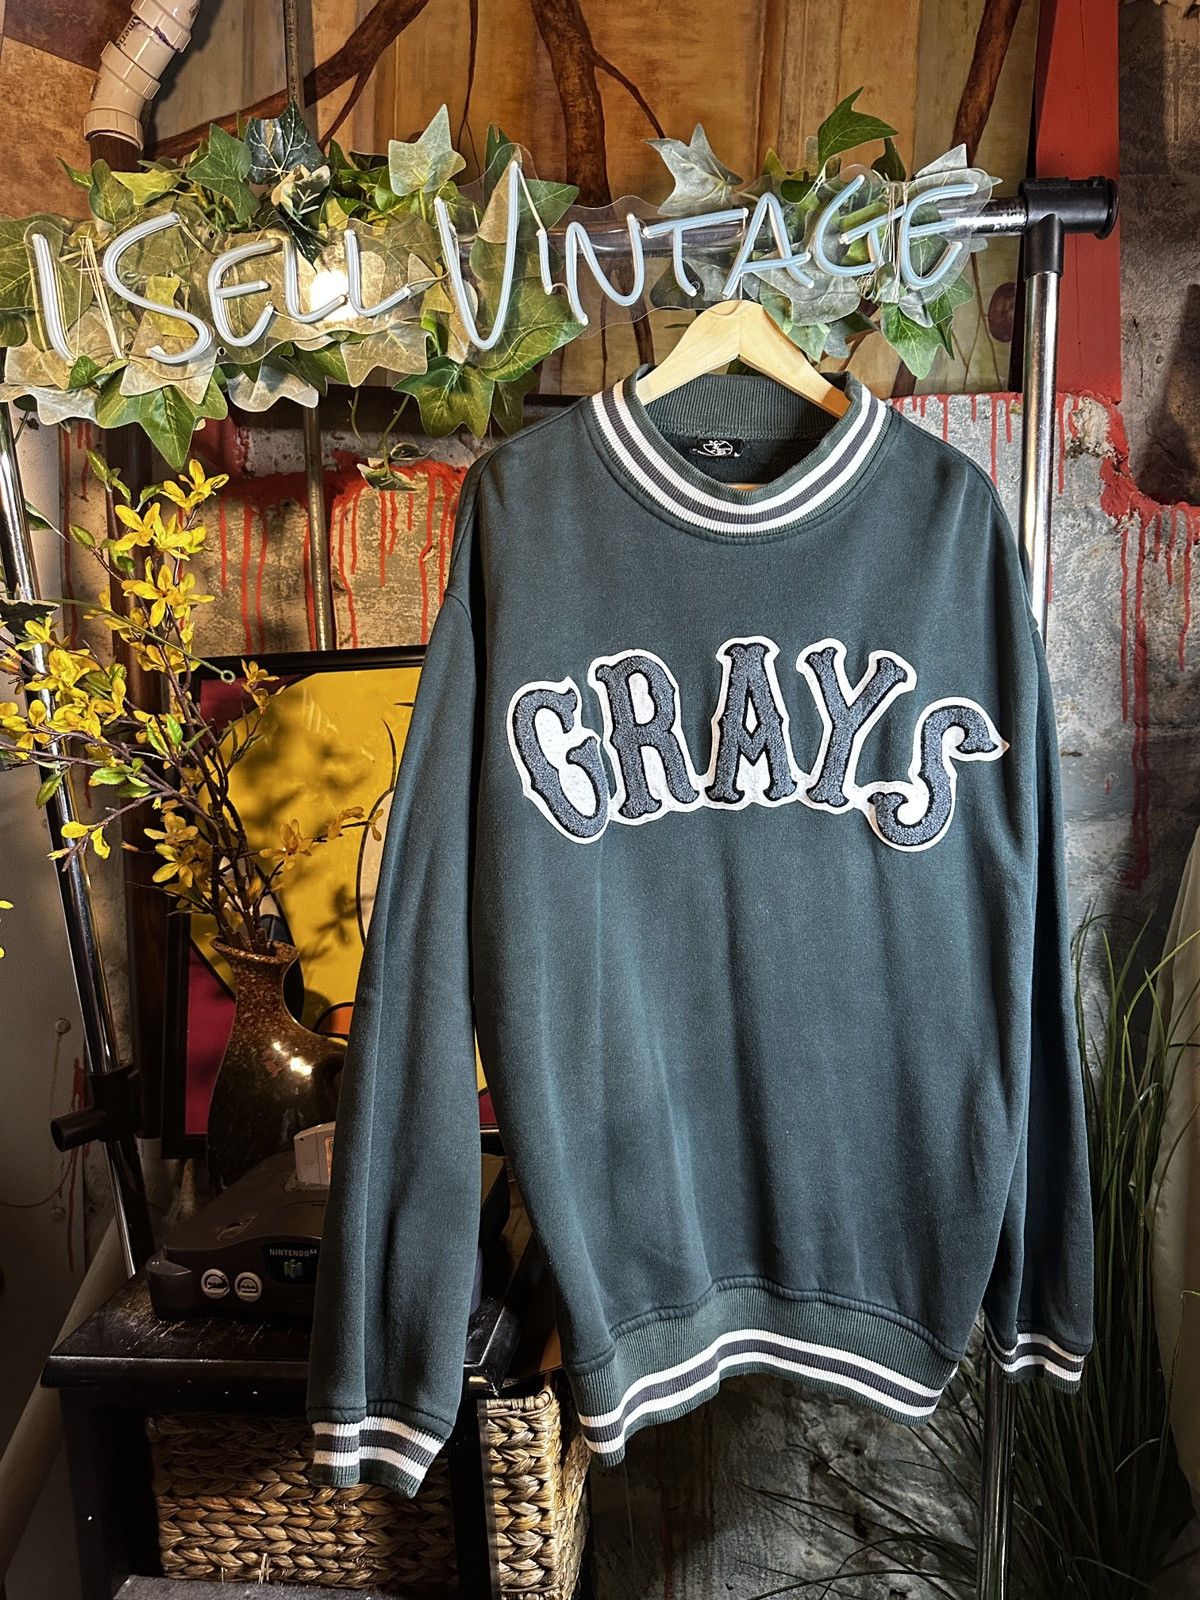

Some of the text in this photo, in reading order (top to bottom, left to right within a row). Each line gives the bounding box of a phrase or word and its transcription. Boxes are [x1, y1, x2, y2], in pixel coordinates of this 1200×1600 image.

[31, 160, 979, 367] I SELL VINTAGE
[506, 636, 1010, 852] GRAYS
